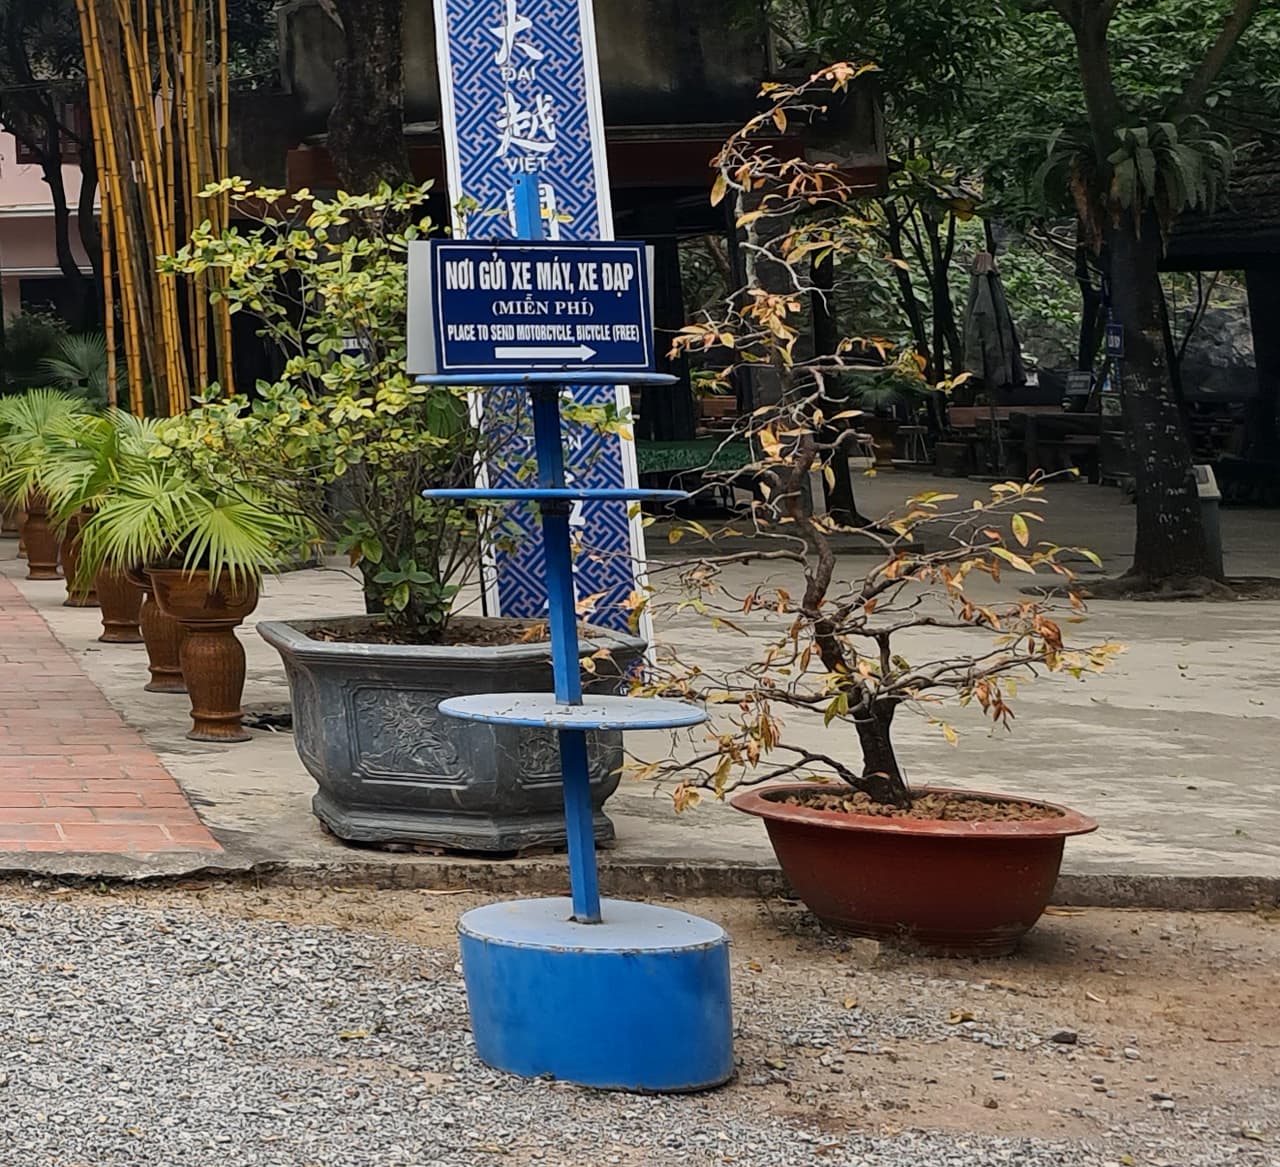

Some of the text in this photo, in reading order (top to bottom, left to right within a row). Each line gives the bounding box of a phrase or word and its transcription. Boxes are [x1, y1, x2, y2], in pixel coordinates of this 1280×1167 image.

[445, 252, 634, 297] NƠI GỬI XE MÁY, XE ĐẠP
[492, 294, 594, 316] (MIỄN PHÍ)
[448, 324, 640, 343] PLACE TO SEND MOTORCYCLE, BICYCLE (FREE)
